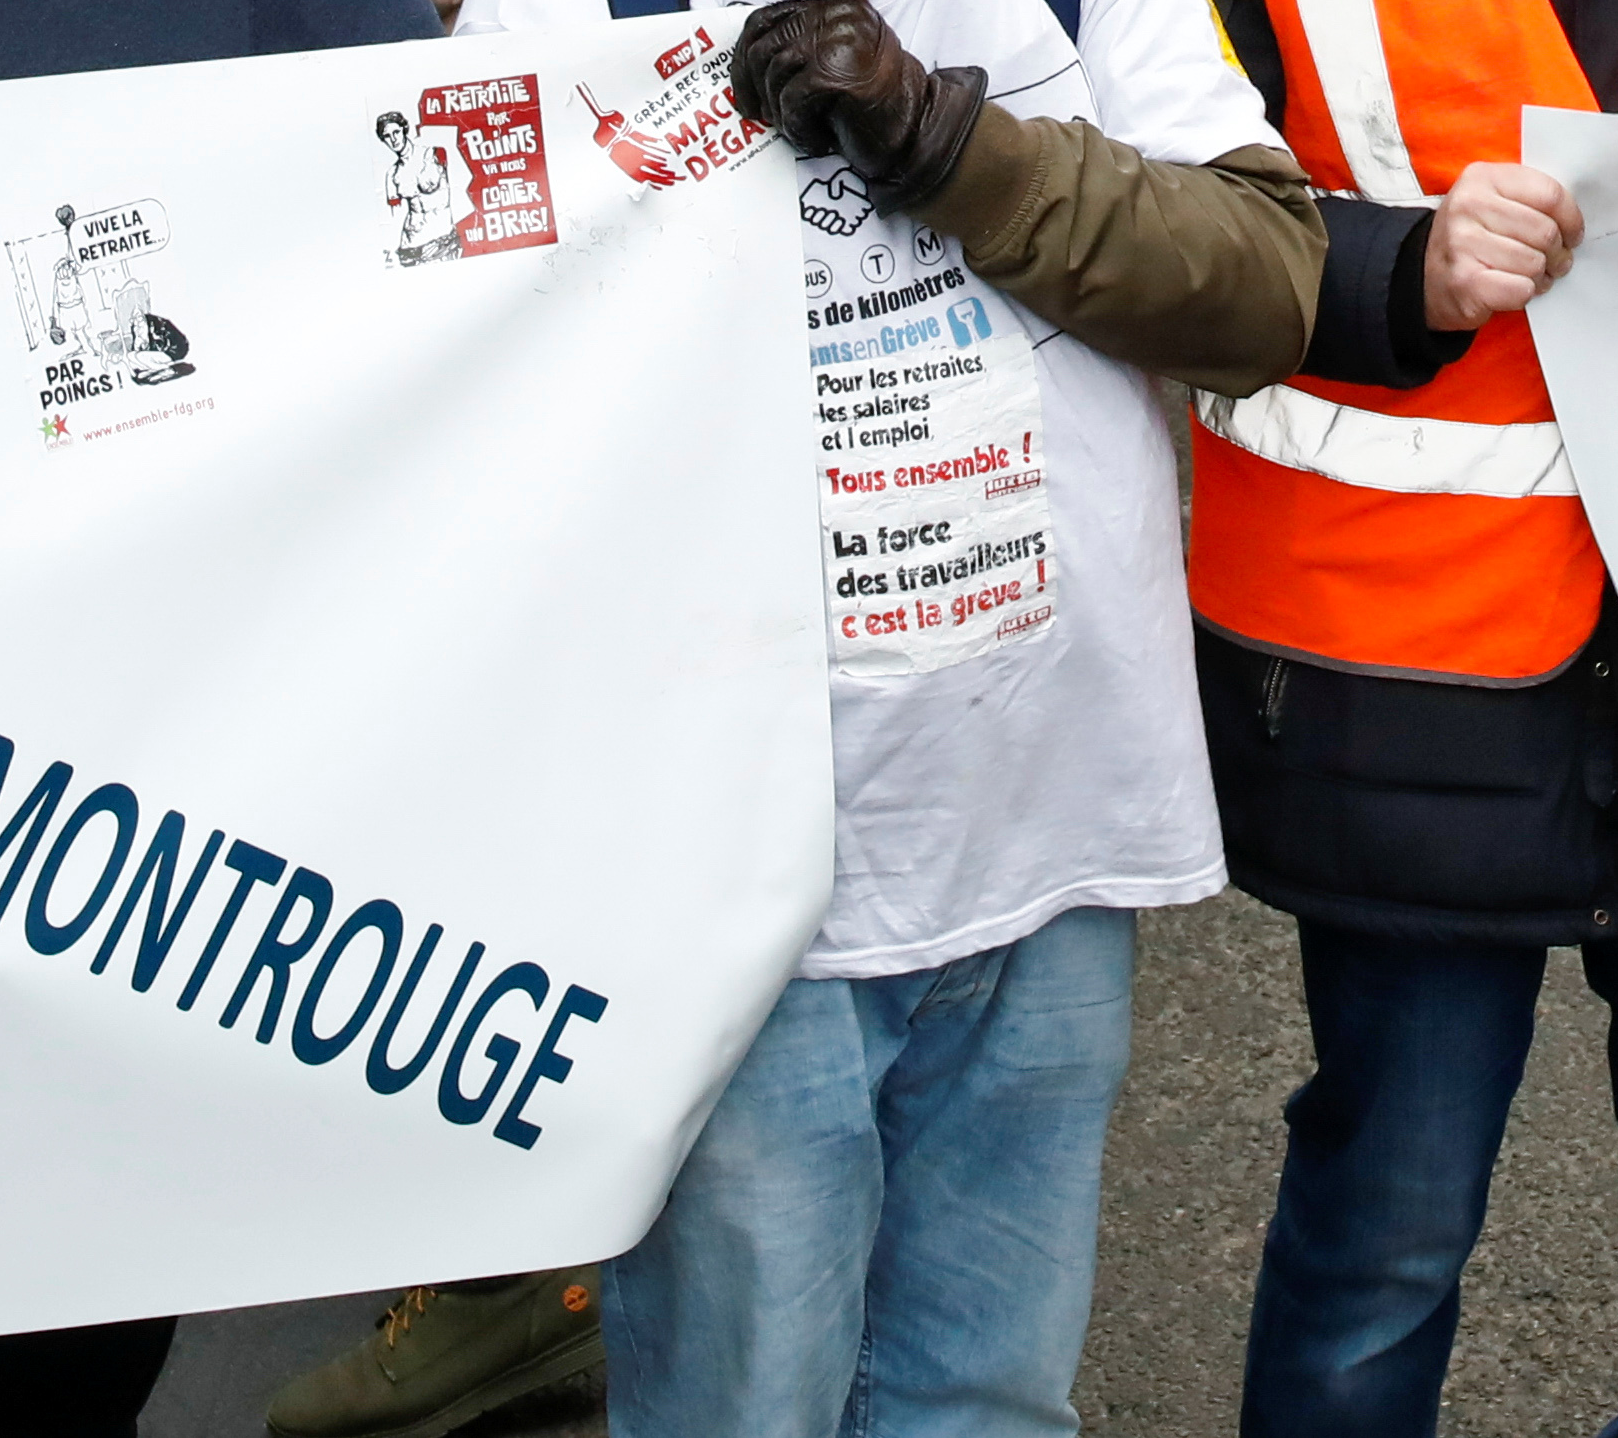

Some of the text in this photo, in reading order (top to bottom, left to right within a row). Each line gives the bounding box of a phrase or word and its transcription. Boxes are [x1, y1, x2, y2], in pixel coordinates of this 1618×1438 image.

[426, 79, 531, 115] LA RETRAITE
[634, 90, 674, 125] GRÈVE
[486, 111, 511, 126] PAR
[462, 124, 538, 161] POINTS
[685, 118, 772, 182] DÉGA
[482, 158, 527, 175] VA NOUS
[84, 210, 143, 238] VIVE LA
[917, 230, 941, 258] M
[868, 253, 884, 275] T
[824, 301, 854, 326] de
[857, 266, 966, 321] kilomètres
[45, 359, 85, 385] PAR
[816, 373, 863, 397] Pour
[869, 368, 898, 390] les
[39, 374, 114, 410] POINGS
[818, 393, 931, 423] les salaires
[83, 396, 215, 441] www.ensemble-fdg.org
[821, 430, 842, 452] et
[825, 467, 887, 495] Tous
[893, 444, 1010, 488] ensemble
[833, 520, 952, 559] La force
[836, 531, 1046, 599] des travailleurs
[915, 598, 942, 630] la
[951, 579, 1023, 626] grève
